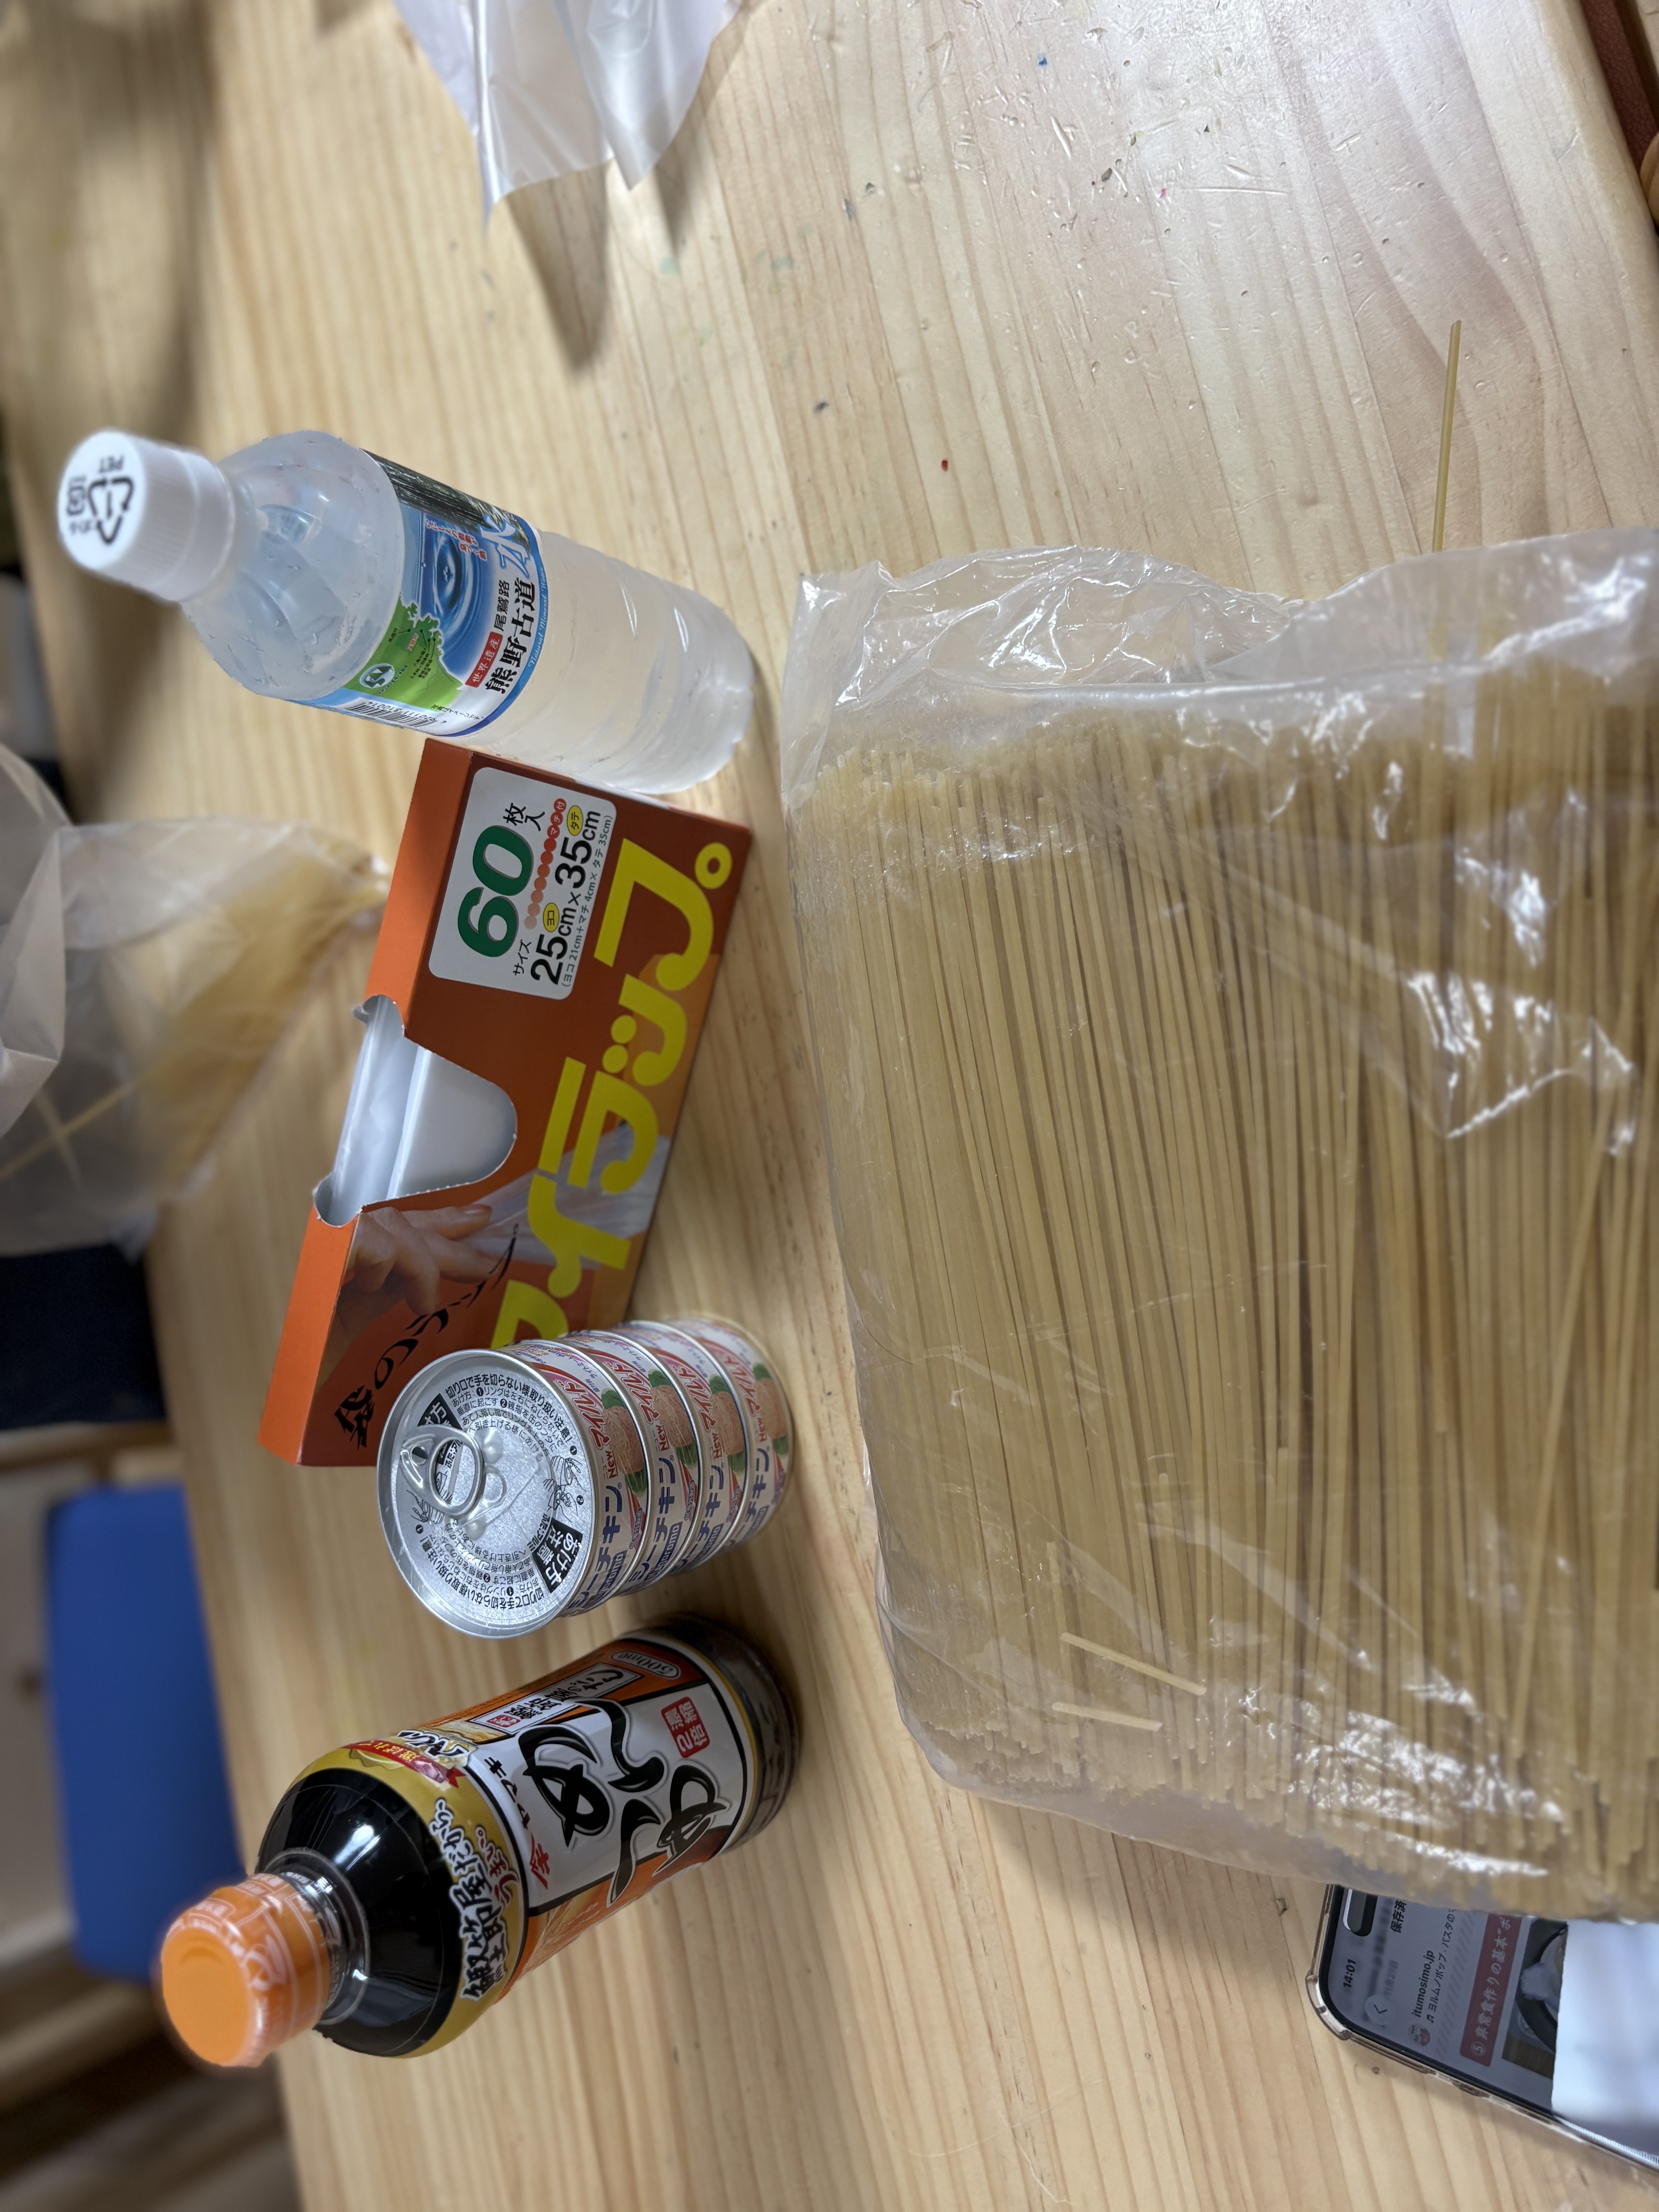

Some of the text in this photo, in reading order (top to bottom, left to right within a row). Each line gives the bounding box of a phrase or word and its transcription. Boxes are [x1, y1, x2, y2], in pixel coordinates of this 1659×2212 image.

[98, 455, 124, 473] PET
[477, 515, 529, 577] 水
[494, 579, 510, 632] 尾鷲路
[527, 566, 548, 667] Natural Mineral Water
[472, 638, 500, 683] 世界遺産
[485, 577, 535, 694] 熊野古道
[550, 800, 565, 836] マチ付
[570, 811, 580, 830] タテ
[457, 825, 534, 958] 60
[547, 910, 555, 926] ヨコ
[513, 939, 532, 976] サイズ
[554, 1378, 611, 1449] マイルド
[603, 1360, 669, 1452] New マイルド
[669, 1364, 718, 1432] マイルド
[605, 1450, 617, 1479] New
[712, 1432, 721, 1459] New
[536, 1525, 564, 1566] 注意
[628, 1457, 675, 1582] シーチキン
[545, 1532, 581, 1585] あけ方
[567, 1486, 622, 1609] シーチキン
[662, 1701, 697, 1730] 濃縮
[678, 1724, 708, 1753] 2倍
[484, 1756, 531, 1830] ヤマキ
[477, 1829, 519, 1903] うまい。
[1343, 1958, 1357, 1989] 14:01
[1411, 1950, 1435, 2018] itumosimo.jp
